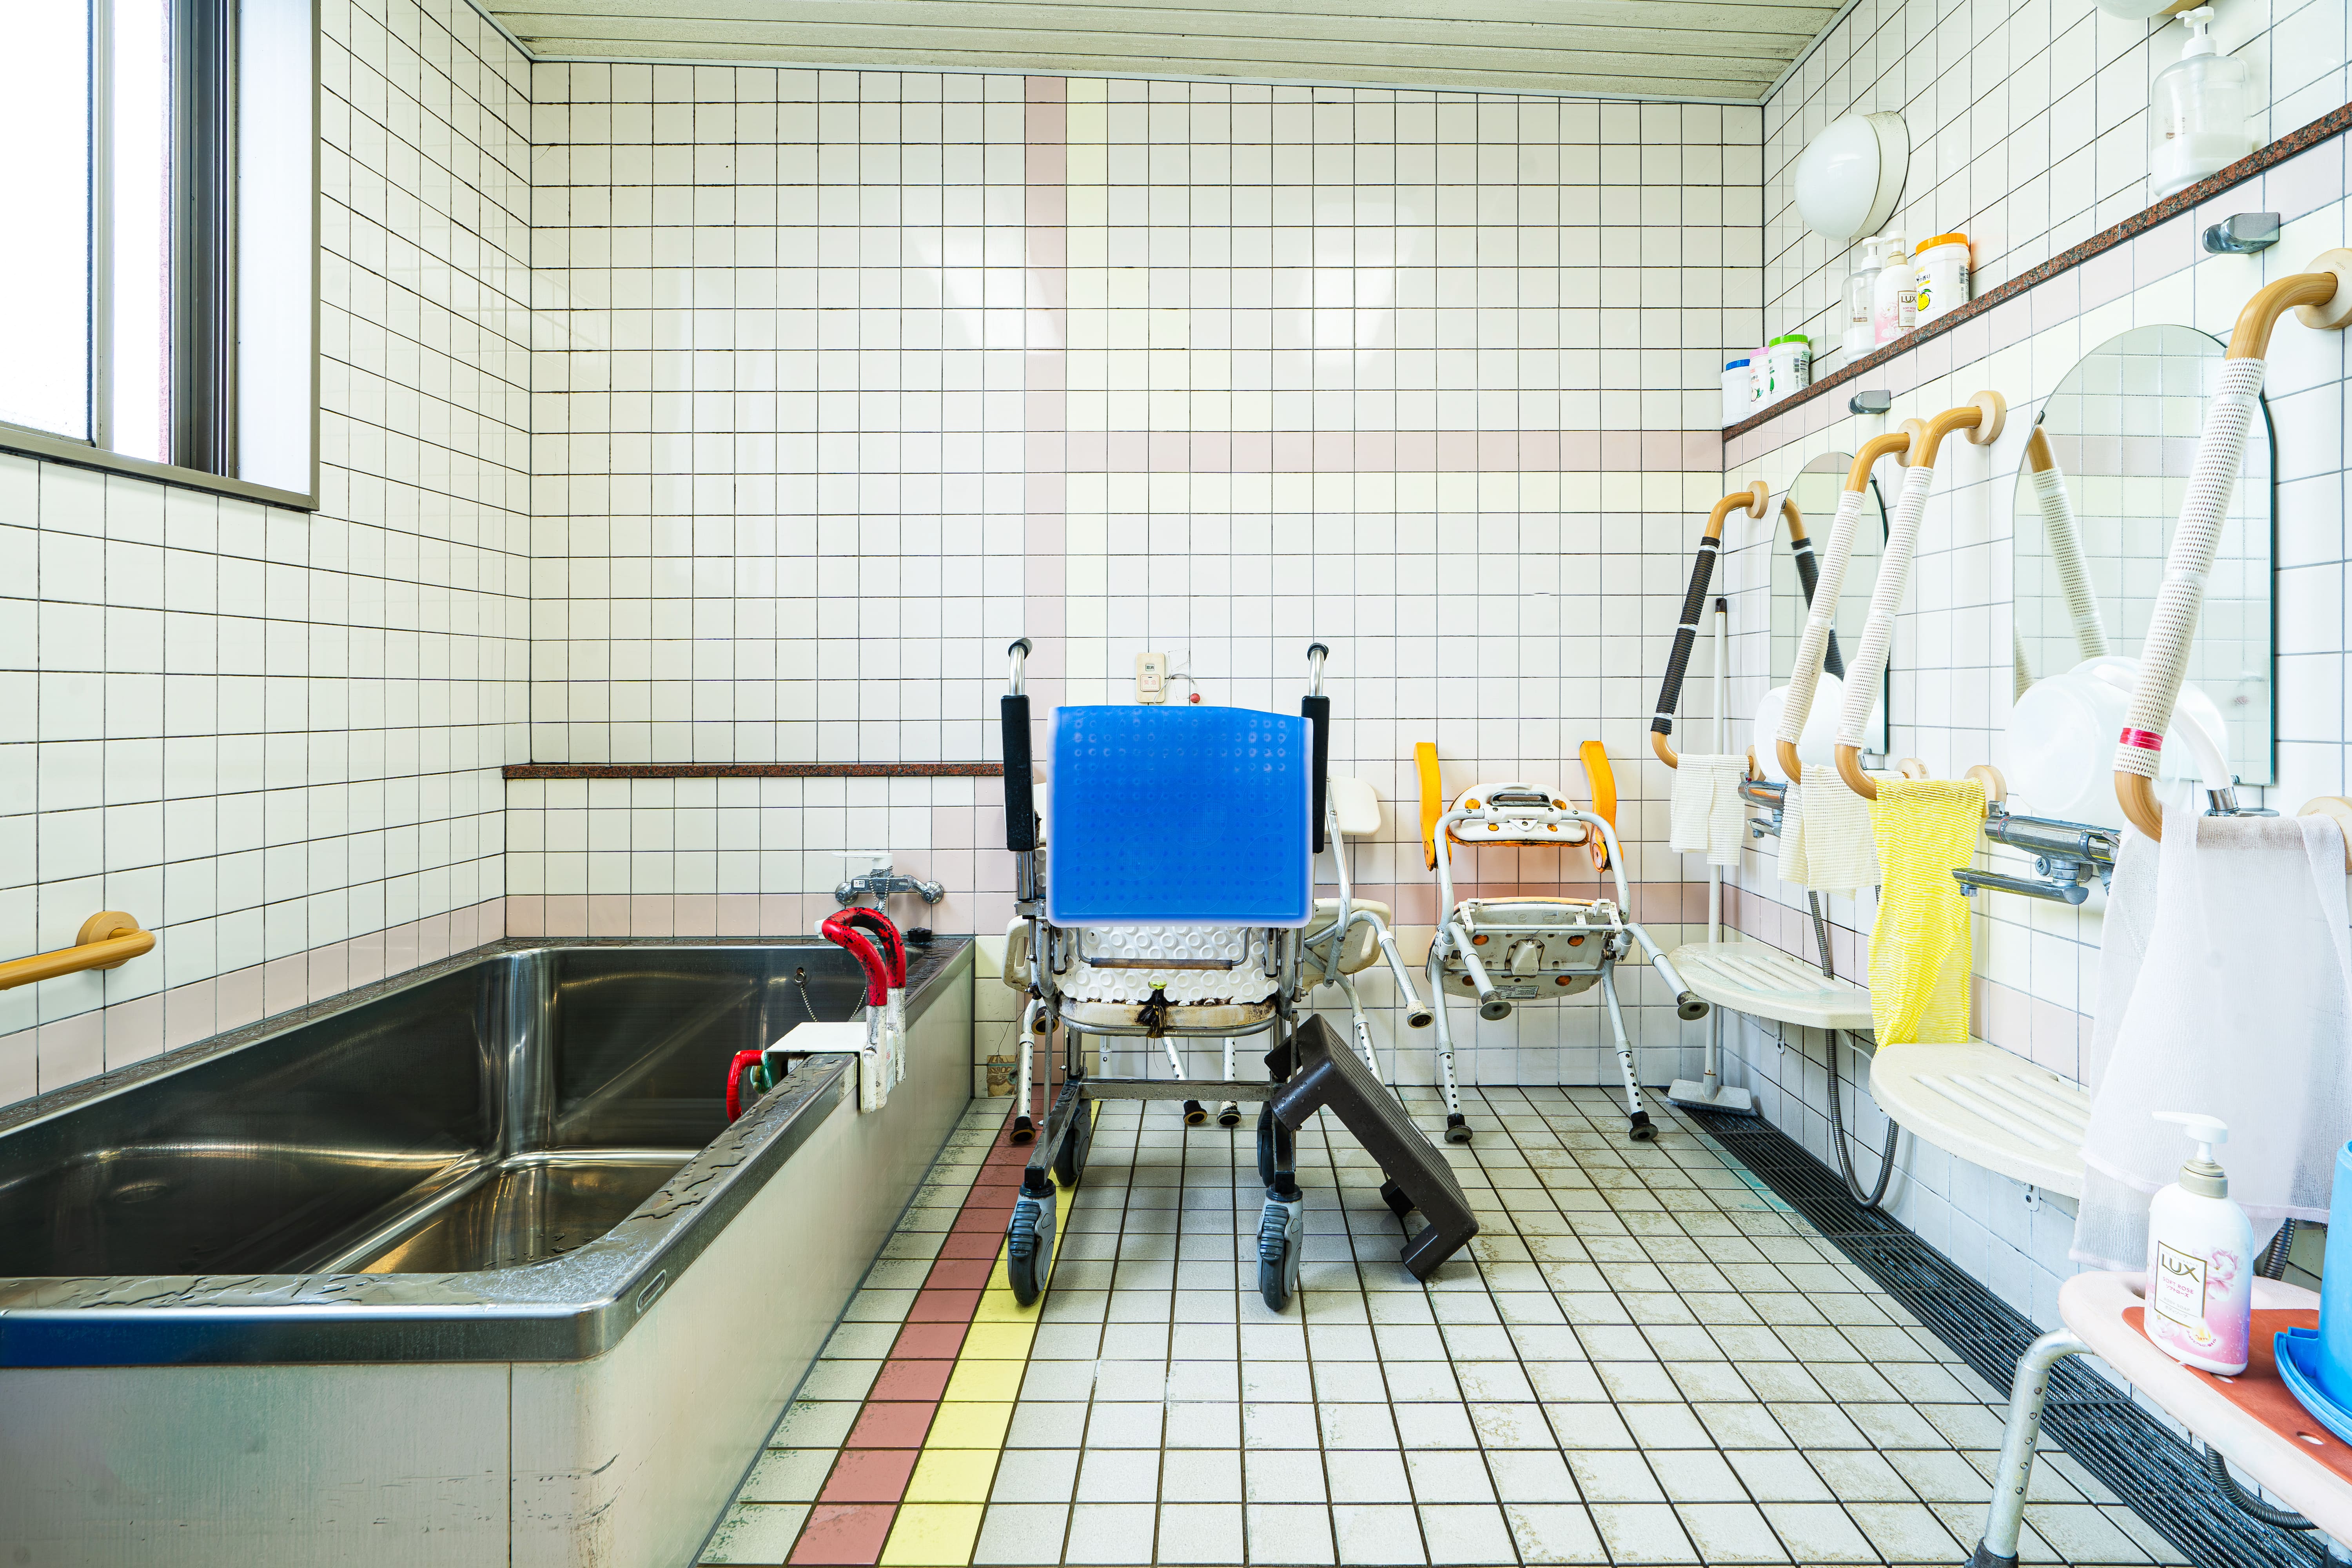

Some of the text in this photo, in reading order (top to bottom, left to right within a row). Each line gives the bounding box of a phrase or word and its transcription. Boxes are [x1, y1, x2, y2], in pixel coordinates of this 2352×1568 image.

[2162, 1254, 2200, 1283] LUX
[2163, 1276, 2194, 1294] SOFT ROSE
[2166, 1284, 2189, 1298] ソフトローズ
[2164, 1297, 2175, 1305] BODY
[2165, 1305, 2188, 1318] ボディソープ
